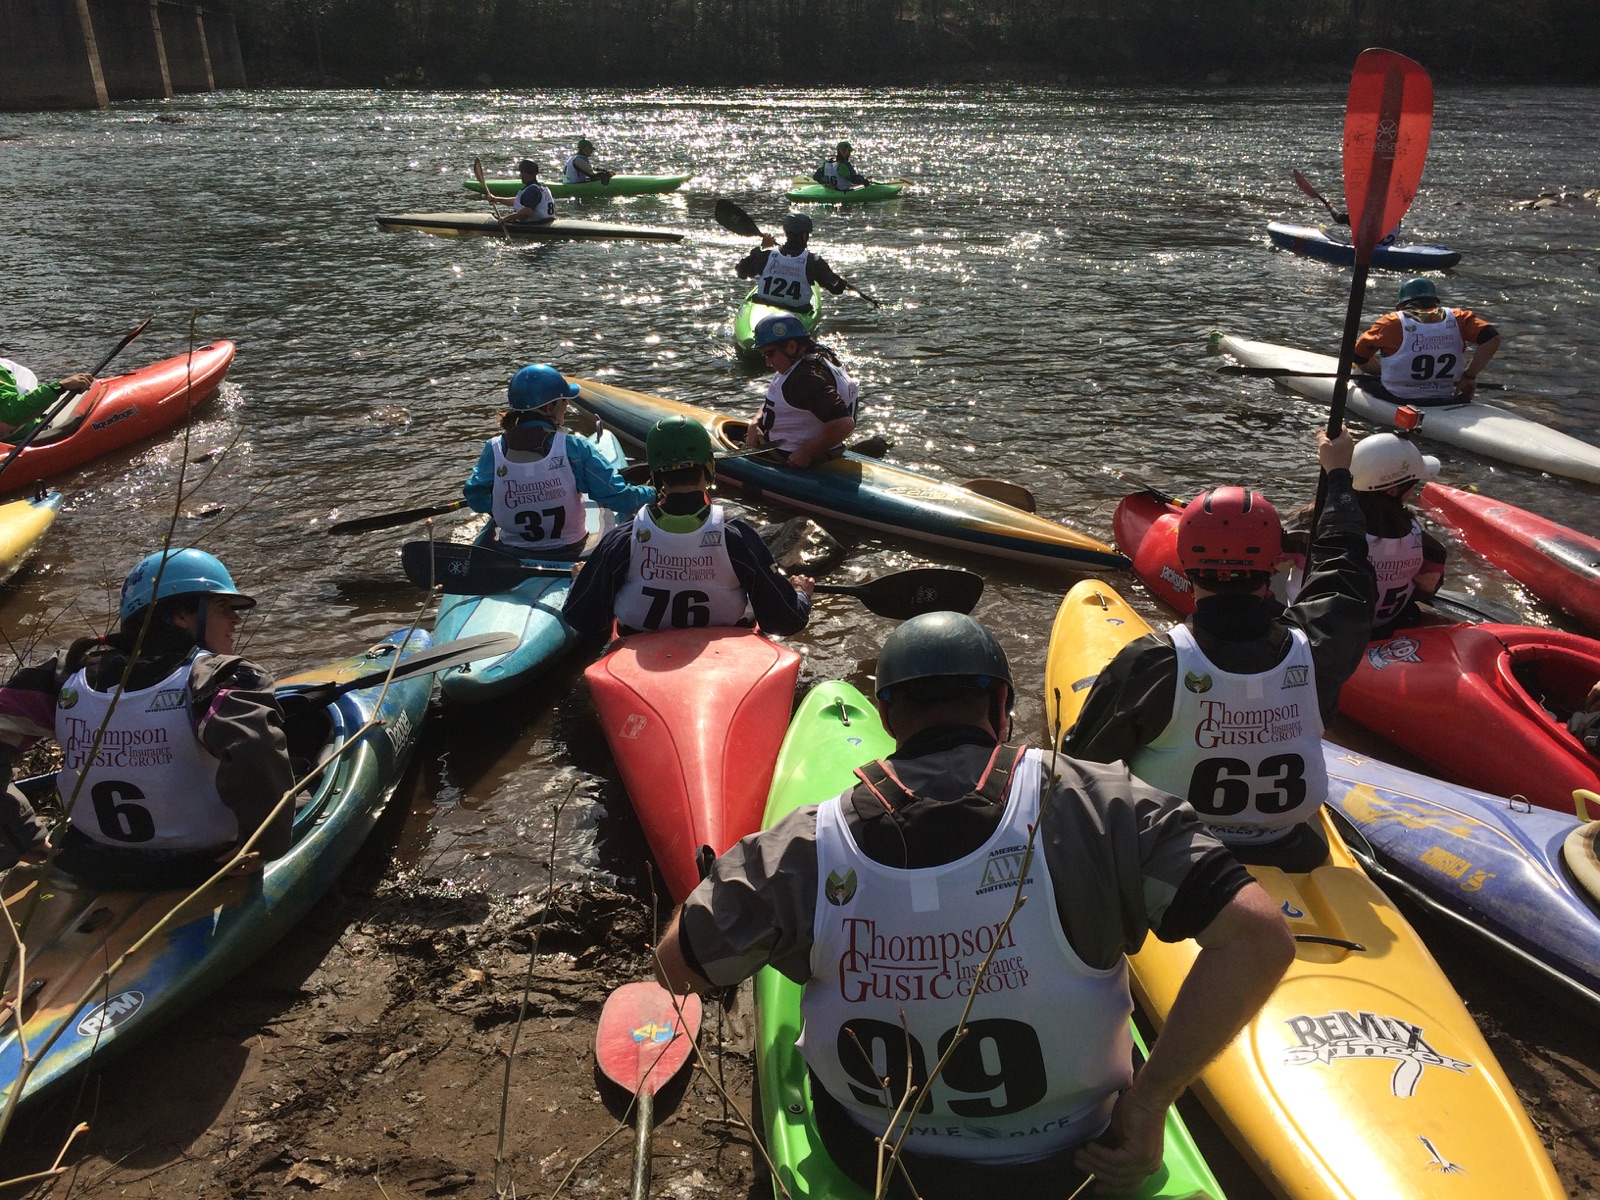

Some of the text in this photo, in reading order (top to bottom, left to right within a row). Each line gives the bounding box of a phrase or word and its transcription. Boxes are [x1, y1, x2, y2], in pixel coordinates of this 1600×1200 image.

[763, 276, 801, 300] 124
[1411, 354, 1456, 380] 92
[503, 477, 562, 498] Thompson
[515, 506, 566, 542] 37
[642, 546, 713, 573] Thompson
[1367, 555, 1421, 576] hompson
[641, 586, 710, 630] 76
[1376, 583, 1410, 619] 5
[1200, 701, 1299, 731] Thompson
[1195, 718, 1270, 748] Gusic
[1271, 727, 1302, 742] GROUP
[129, 746, 171, 758] Insurance
[129, 754, 173, 767] GROUP
[1188, 753, 1306, 815] 63
[91, 780, 155, 842] 6
[841, 918, 1016, 974] Thompson
[839, 950, 954, 1003] Gusic
[955, 956, 1025, 980] Insrance
[956, 969, 1029, 997] GROUP
[80, 993, 140, 1035] RPM
[837, 1018, 1047, 1118] 99
